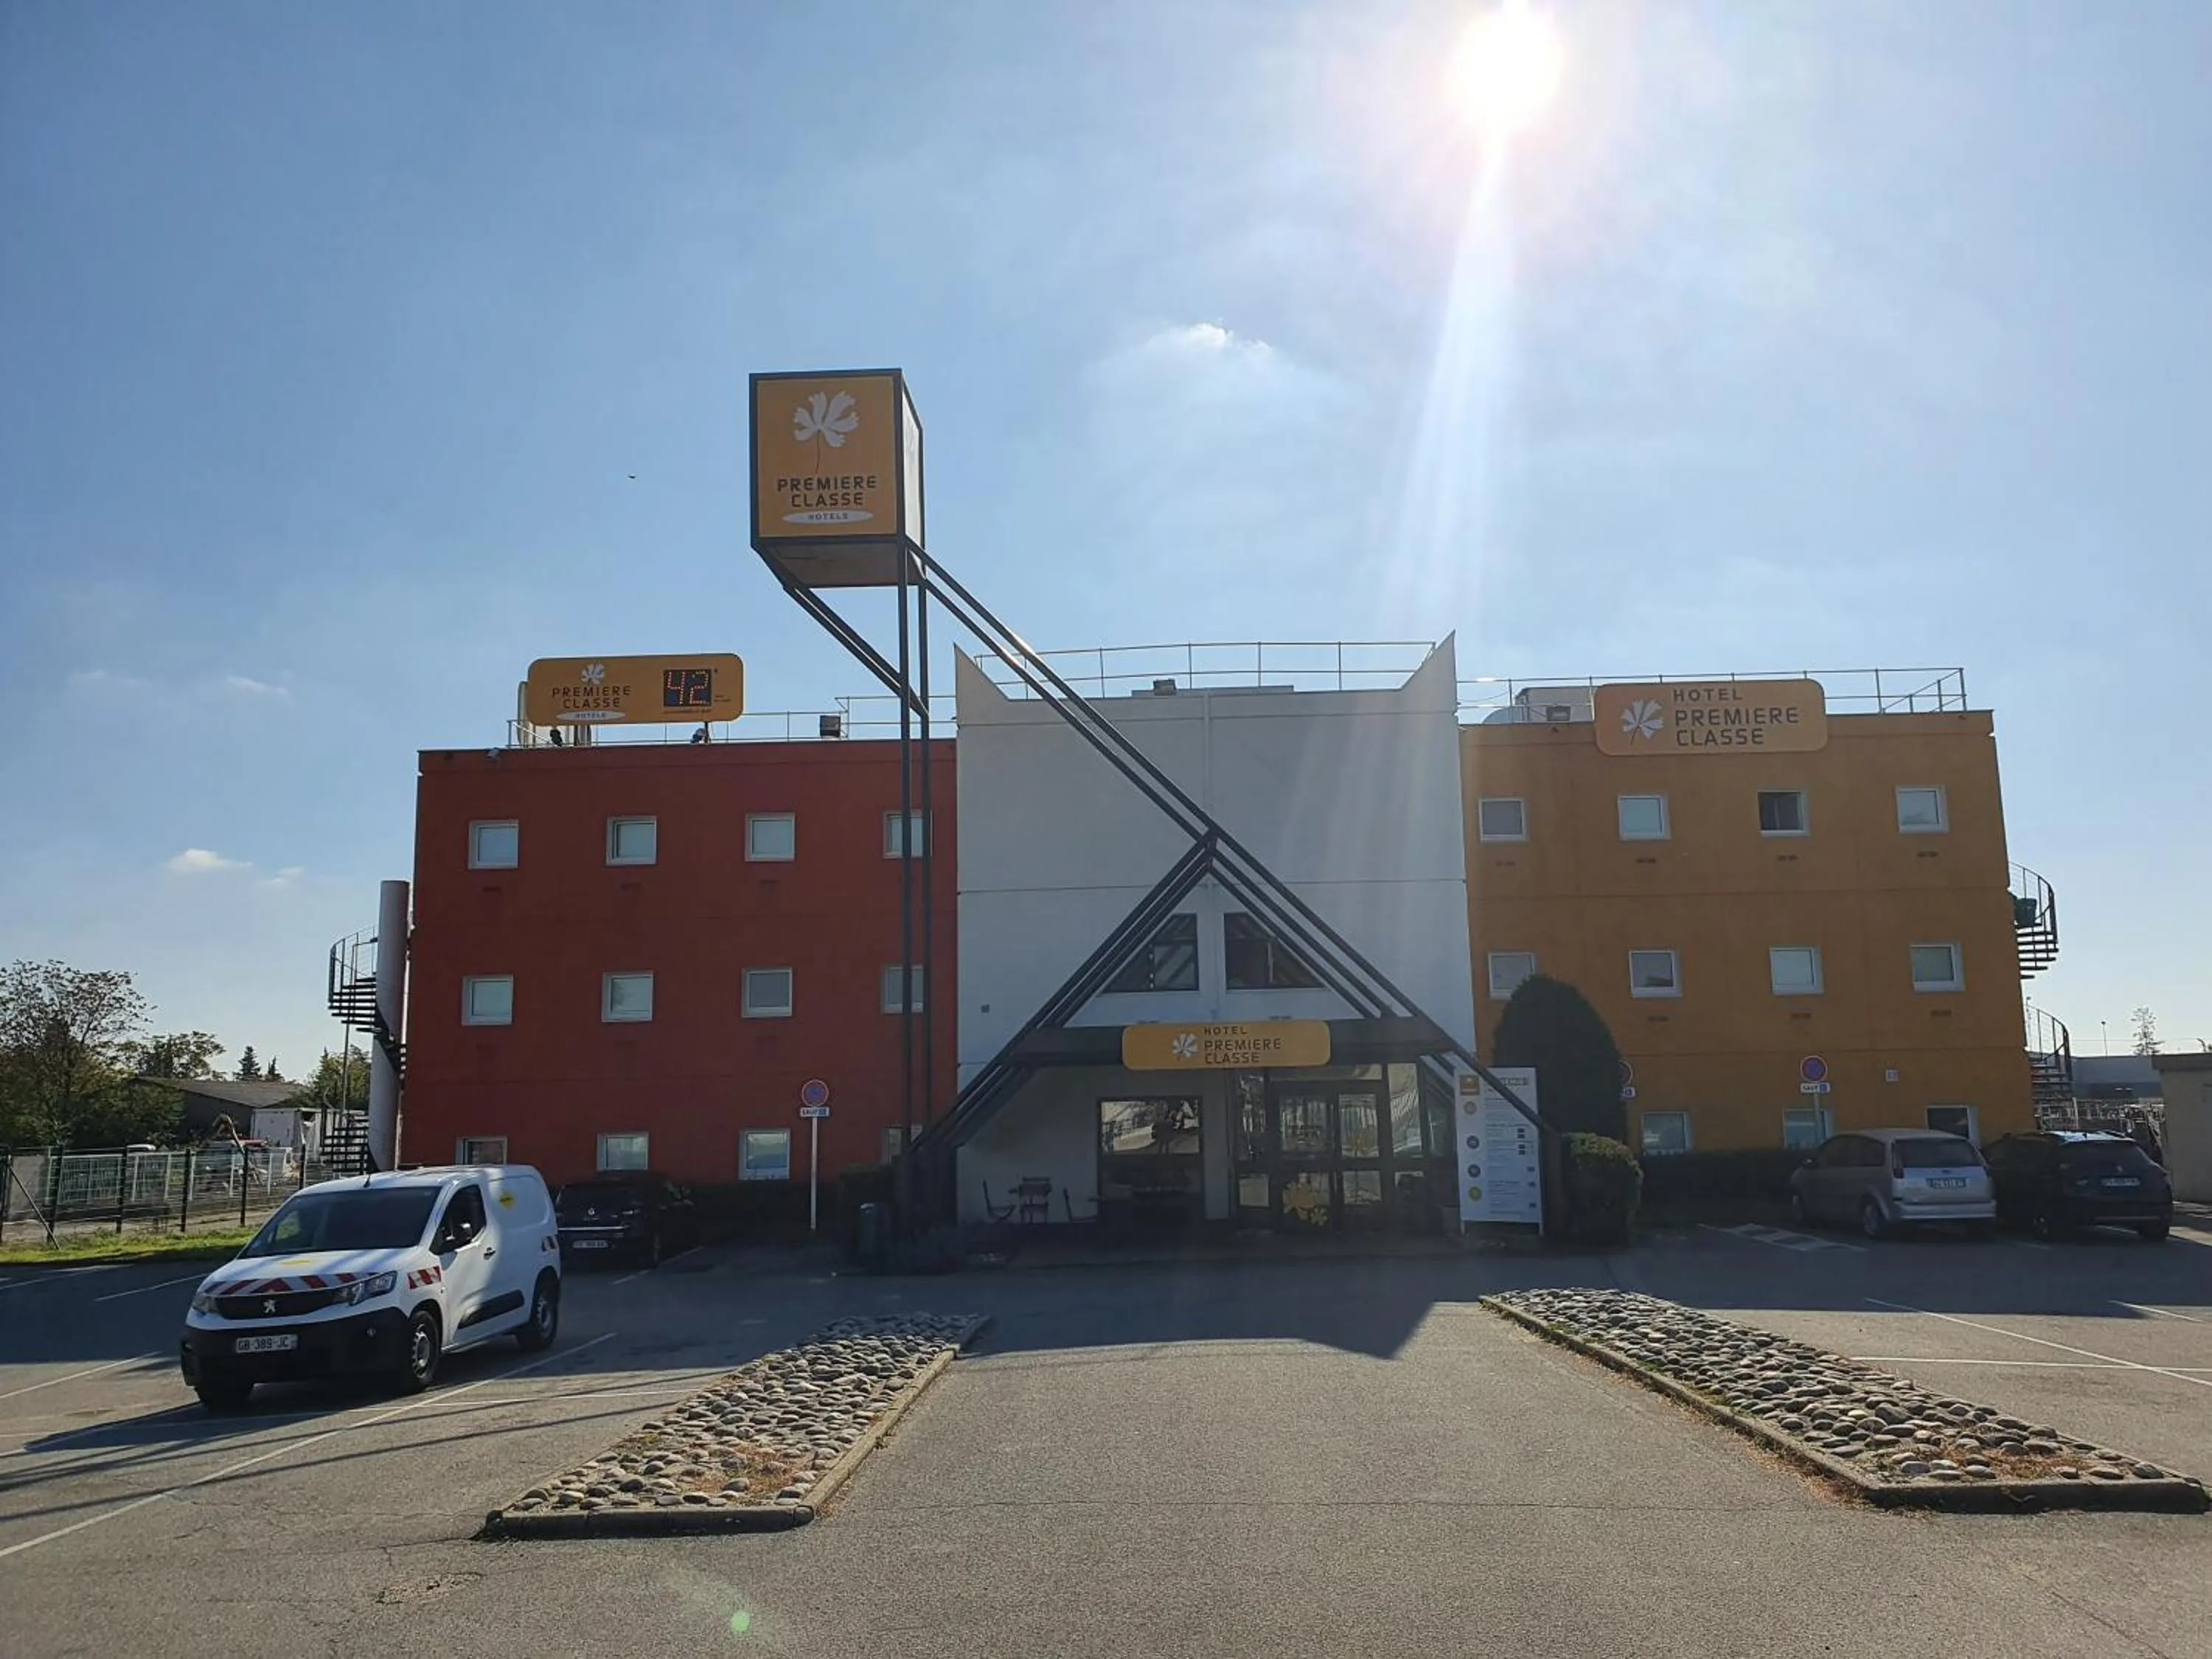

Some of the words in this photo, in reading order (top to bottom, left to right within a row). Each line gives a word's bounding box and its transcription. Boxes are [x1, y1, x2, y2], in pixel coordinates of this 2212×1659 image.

[777, 475, 877, 492] PREMIERE
[790, 492, 863, 508] CLASSE
[552, 685, 631, 698] PREMIERE
[667, 670, 709, 705] 42
[1673, 688, 1743, 702] HOTEL
[563, 698, 622, 709] CLASSE
[1674, 707, 1799, 726] PREMIERE
[1675, 728, 1765, 746] CLASSE
[1204, 1026, 1248, 1035] HOTEL
[1204, 1038, 1281, 1051] PREMIERE
[1204, 1052, 1260, 1065] CLASSE
